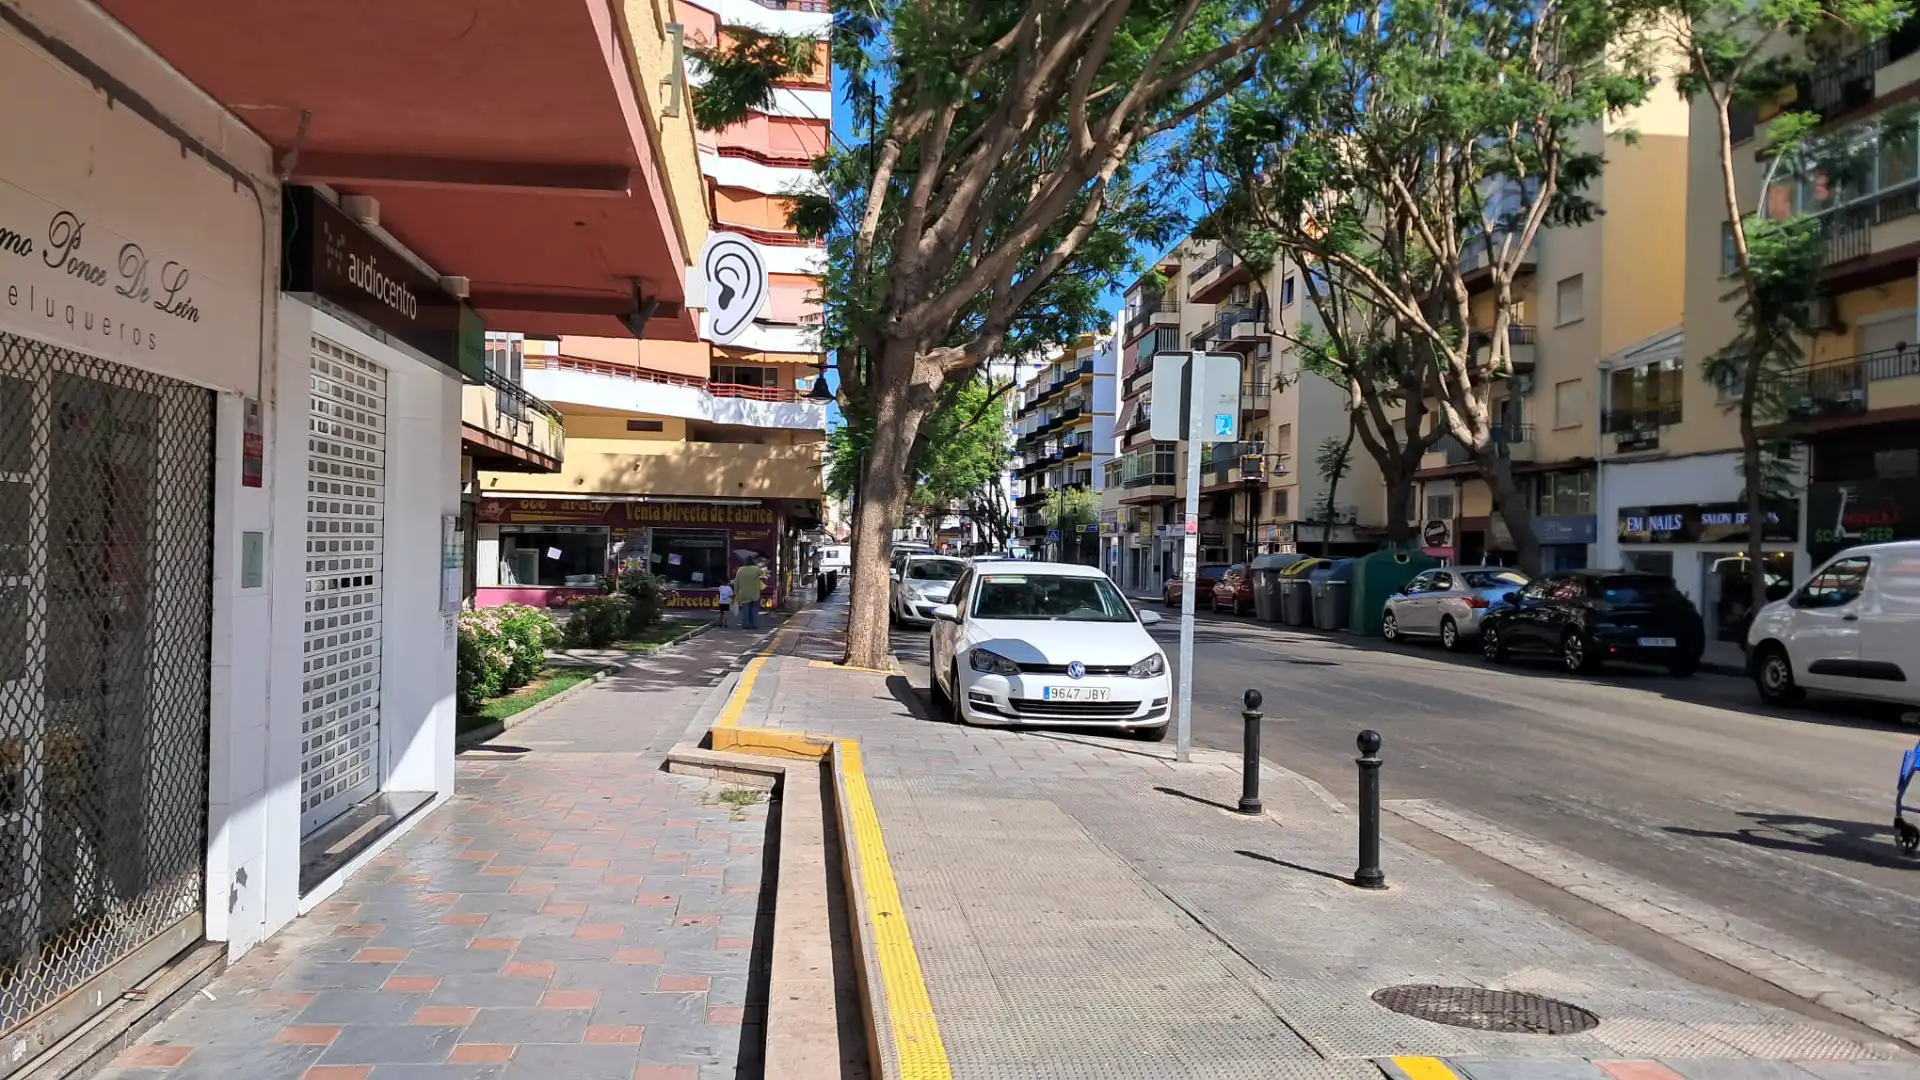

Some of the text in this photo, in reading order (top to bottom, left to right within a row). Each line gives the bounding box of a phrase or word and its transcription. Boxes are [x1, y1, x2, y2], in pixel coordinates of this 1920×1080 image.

[43, 211, 107, 286] Ponce
[115, 243, 150, 304] De
[153, 260, 200, 323] León
[348, 253, 418, 321] audiocentro
[8, 284, 156, 350] eluqueros
[662, 503, 707, 523] Directa
[710, 505, 725, 523] de
[1627, 513, 1683, 532] EM NAILS
[1701, 512, 1732, 525] SALON
[1051, 688, 1106, 701] 9647 JBY
